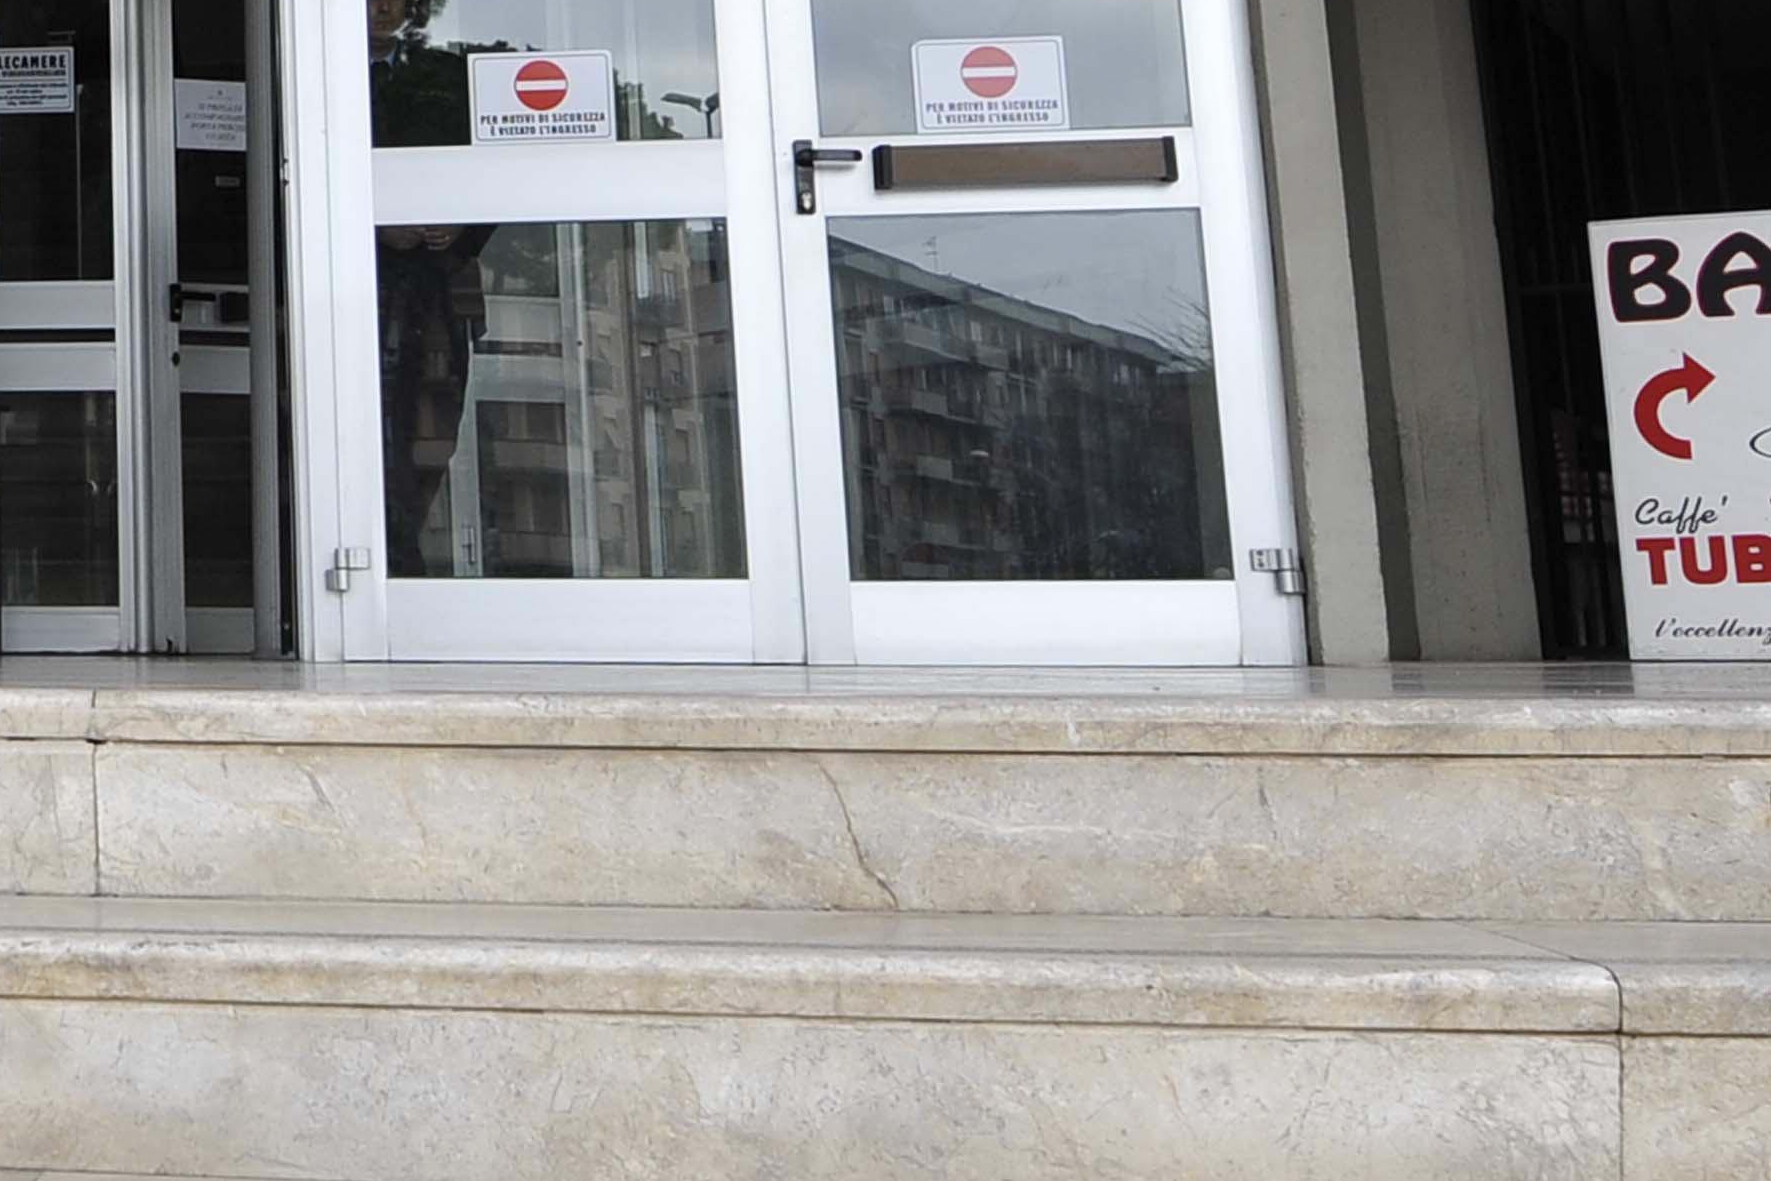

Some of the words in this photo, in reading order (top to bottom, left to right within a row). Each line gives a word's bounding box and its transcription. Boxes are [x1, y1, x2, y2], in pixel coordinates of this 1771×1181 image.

[926, 102, 944, 113] PER
[948, 101, 984, 111] MOTIVI
[987, 101, 998, 111] DI
[1001, 99, 1058, 110] SICUREZZA
[480, 115, 498, 125] PER
[501, 114, 535, 124] MOTIVI
[538, 113, 549, 123] DI
[551, 112, 605, 122] SICUREZZA
[945, 113, 985, 123] VIETATO
[498, 126, 536, 136] VIETATO
[1607, 231, 1771, 323] BA
[1635, 534, 1771, 585] TUB
